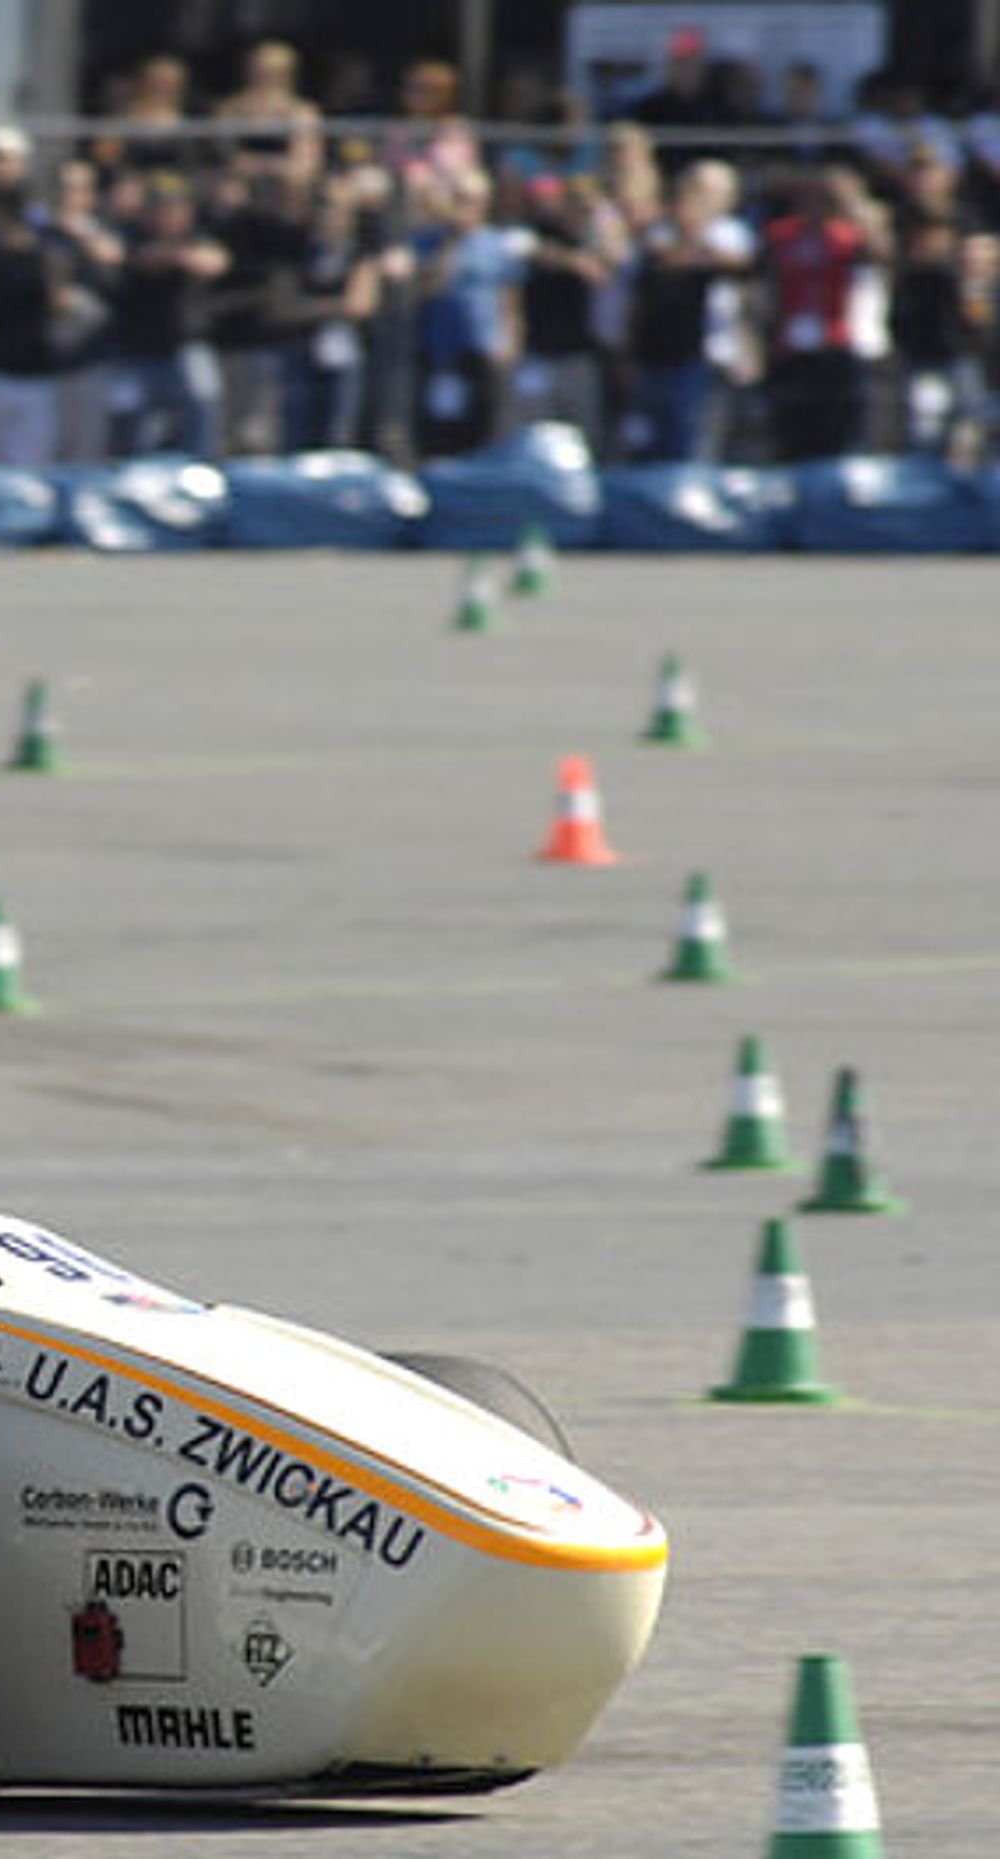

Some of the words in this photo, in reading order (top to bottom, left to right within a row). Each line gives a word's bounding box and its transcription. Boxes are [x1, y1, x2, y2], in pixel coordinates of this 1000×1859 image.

[25, 1352, 165, 1447] U.A.S.
[178, 1415, 424, 1569] ZWICKAU
[94, 1558, 180, 1601] ADAC
[260, 1547, 338, 1574] BOSCH
[117, 1703, 256, 1750] MAHLE
